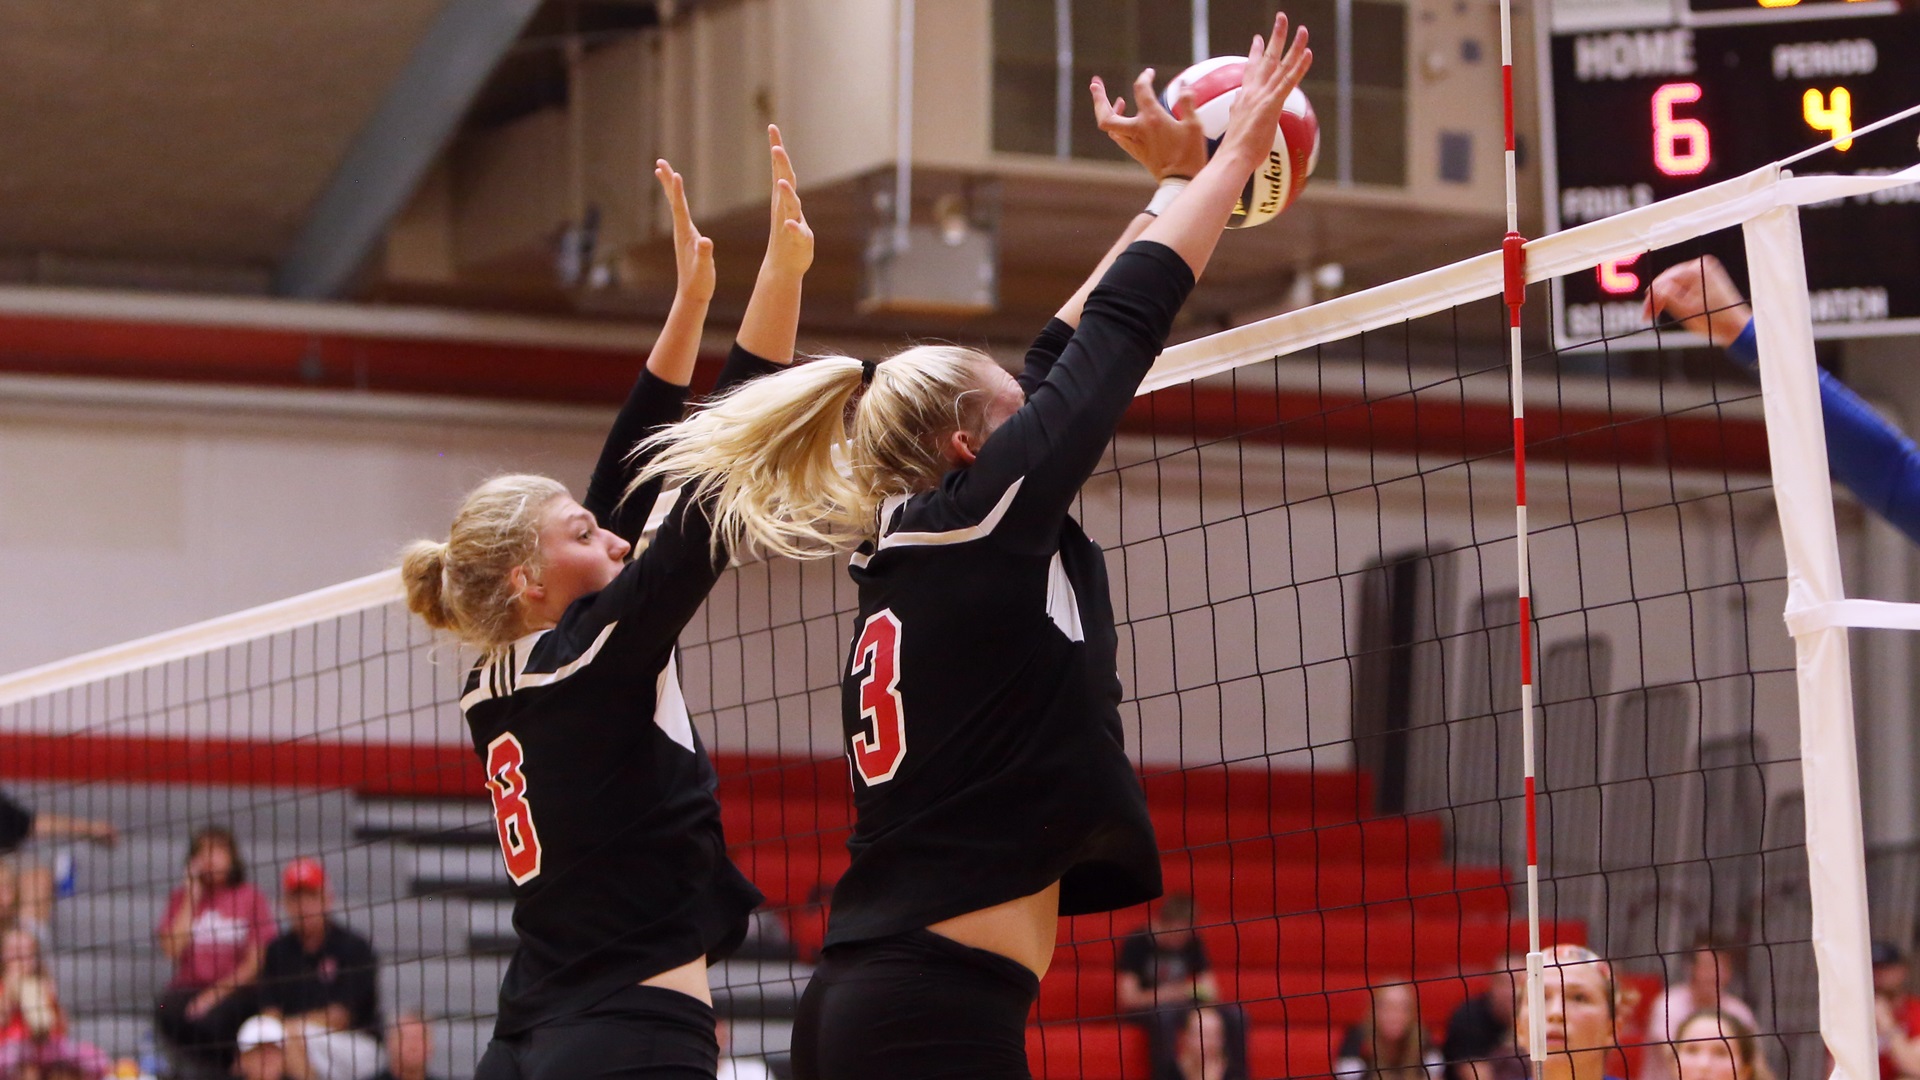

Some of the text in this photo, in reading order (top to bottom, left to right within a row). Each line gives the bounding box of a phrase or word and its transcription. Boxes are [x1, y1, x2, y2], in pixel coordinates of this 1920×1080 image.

[1573, 29, 1697, 81] HOME
[1771, 38, 1878, 79] PERIOD
[1652, 82, 1710, 176] 6
[1803, 86, 1853, 152] 4
[1258, 151, 1283, 213] Baden
[485, 731, 542, 887] 8
